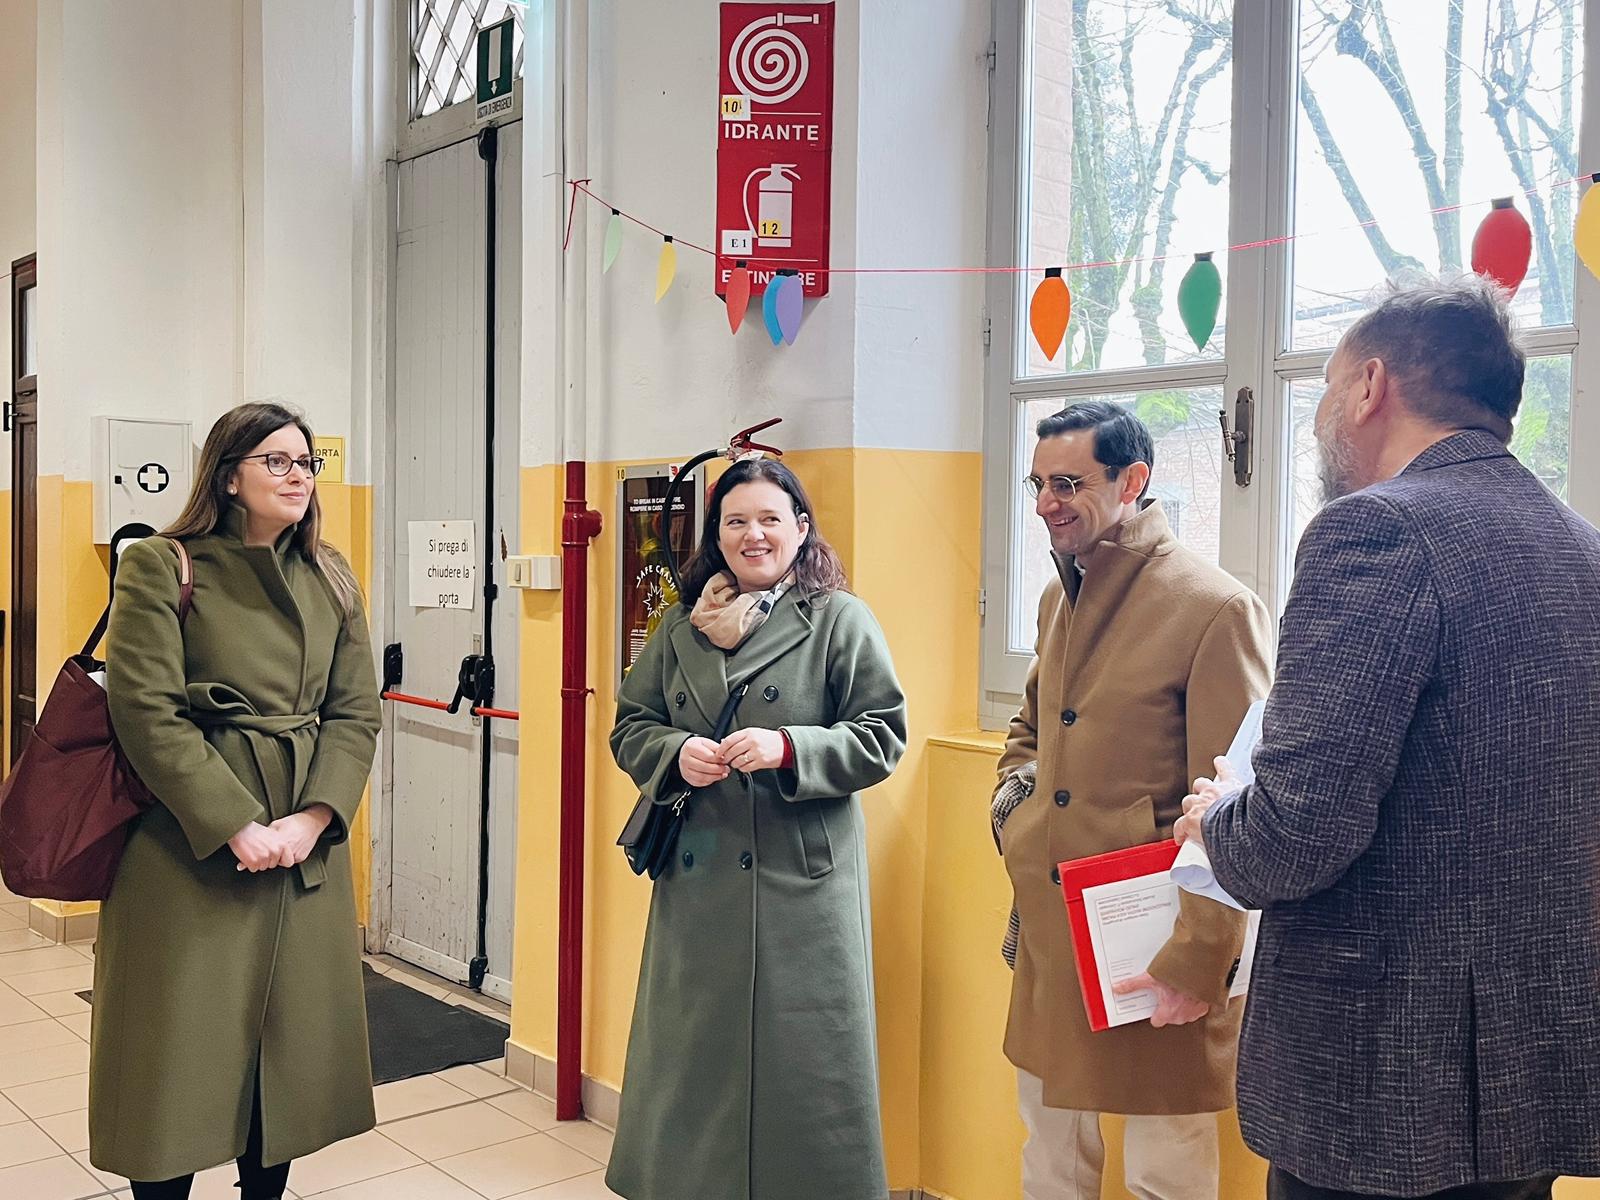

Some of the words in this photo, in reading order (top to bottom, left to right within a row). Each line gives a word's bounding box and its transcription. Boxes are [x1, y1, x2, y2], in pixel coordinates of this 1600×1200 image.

[724, 123, 819, 141] IDRANTE
[315, 448, 340, 457] ORTA
[428, 539, 436, 552] Si
[438, 541, 460, 555] prega
[461, 538, 469, 552] di
[427, 564, 461, 578] chiudere
[462, 564, 470, 578] la
[438, 592, 459, 606] porta
